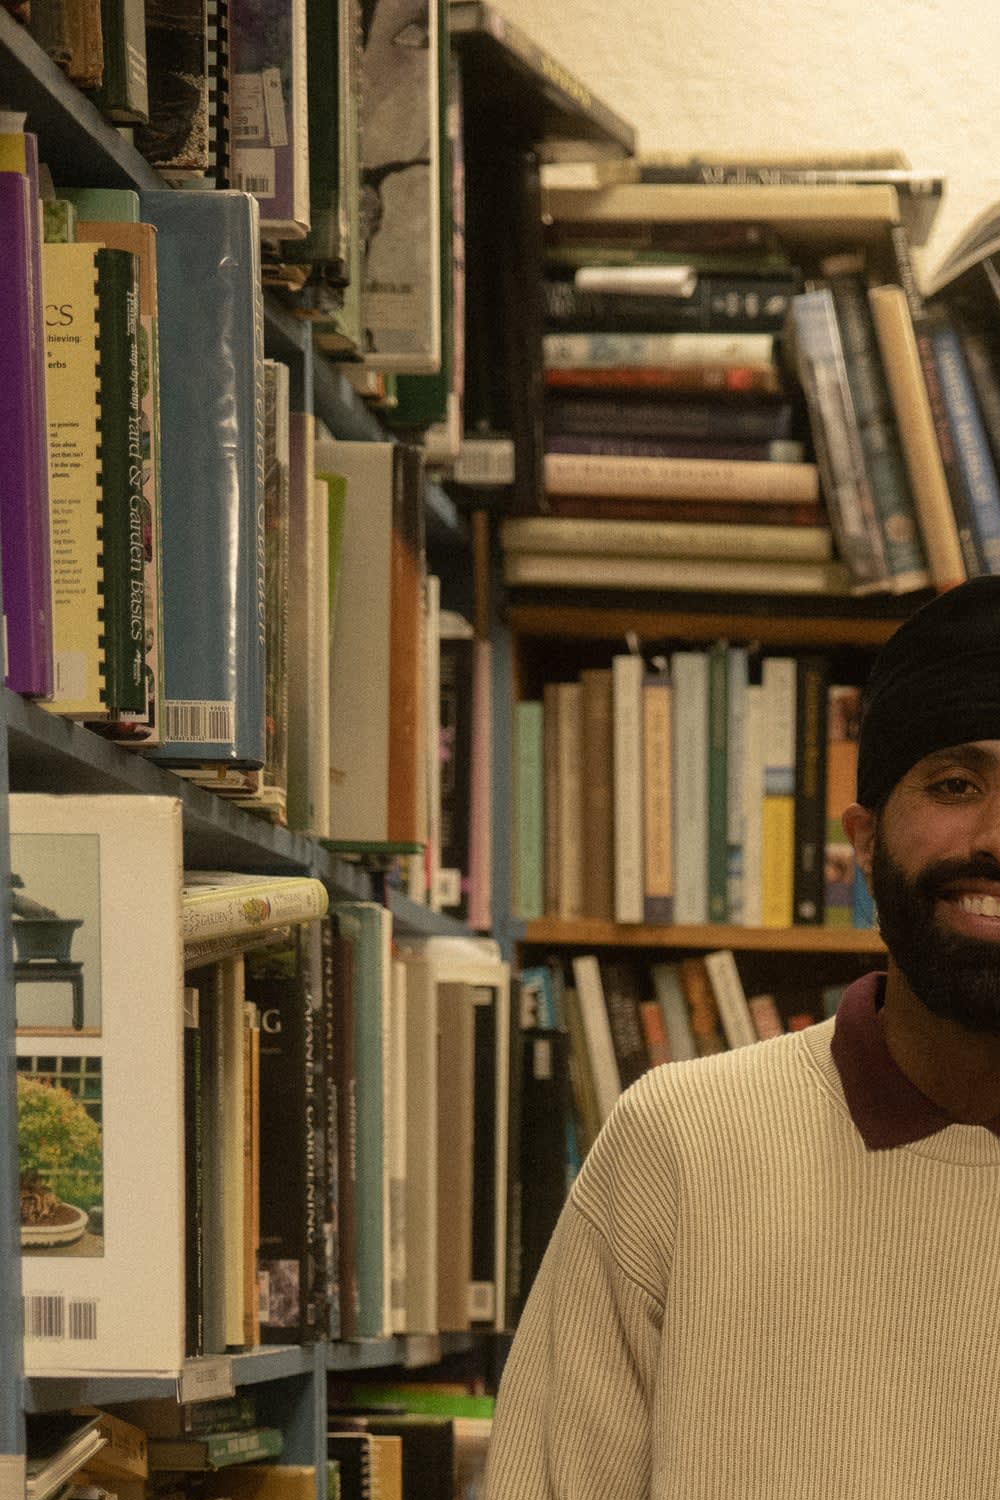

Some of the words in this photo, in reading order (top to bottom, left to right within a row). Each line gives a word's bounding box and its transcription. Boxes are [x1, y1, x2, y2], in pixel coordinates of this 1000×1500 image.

[129, 343, 140, 411] step-by-step
[127, 415, 143, 460] Yard
[128, 465, 143, 491] &
[128, 495, 145, 572] Garden
[130, 579, 145, 641] Basics
[305, 1106, 317, 1243] GARDENING
